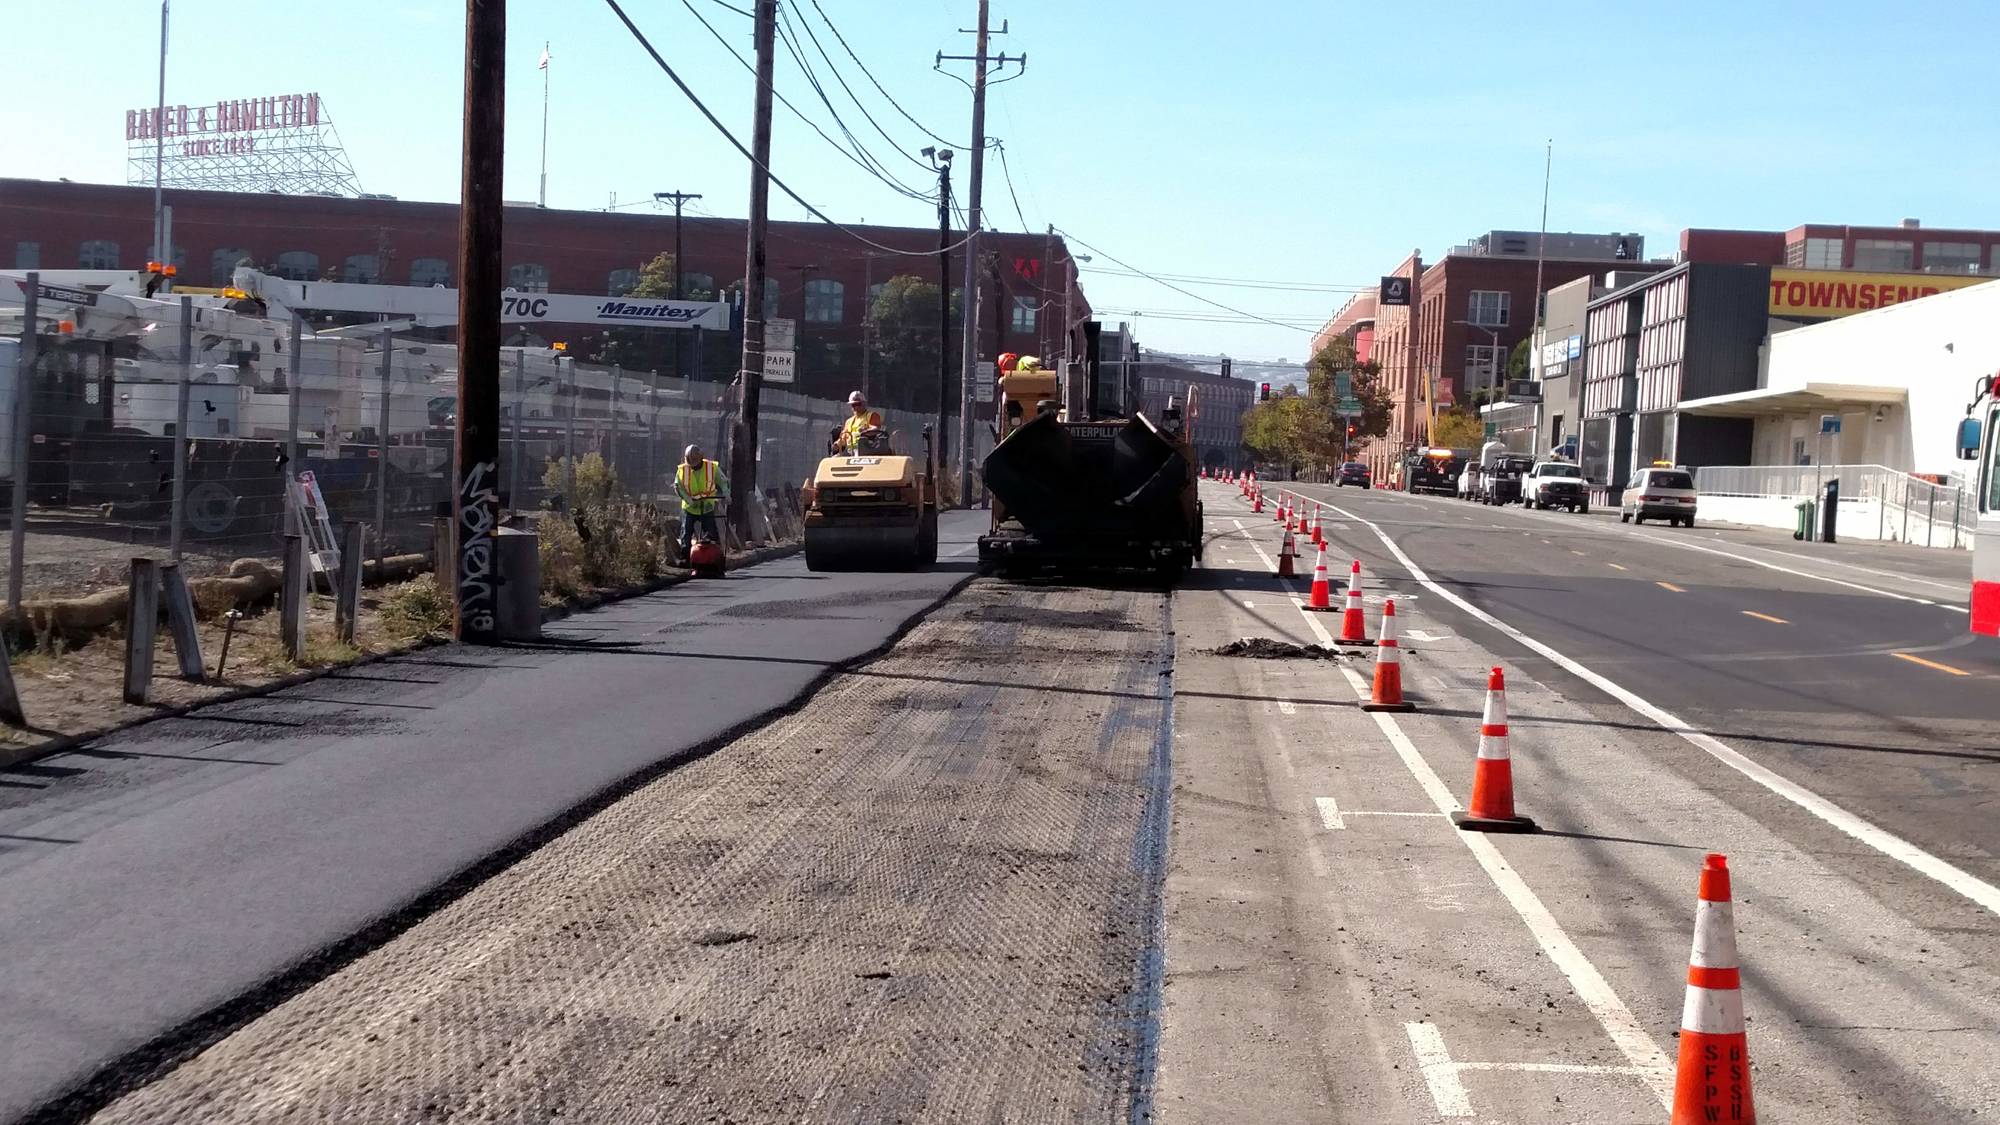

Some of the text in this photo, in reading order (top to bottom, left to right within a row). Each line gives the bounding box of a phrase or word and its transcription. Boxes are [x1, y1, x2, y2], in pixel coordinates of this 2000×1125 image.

[126, 92, 319, 140] BAKER & HAMILTON
[183, 139, 220, 157] SINCE
[49, 288, 88, 302] TEREX
[1771, 281, 1939, 309] TOWNSEN
[501, 297, 548, 317] 70C
[601, 302, 697, 319] Manitex
[766, 356, 792, 366] PARK
